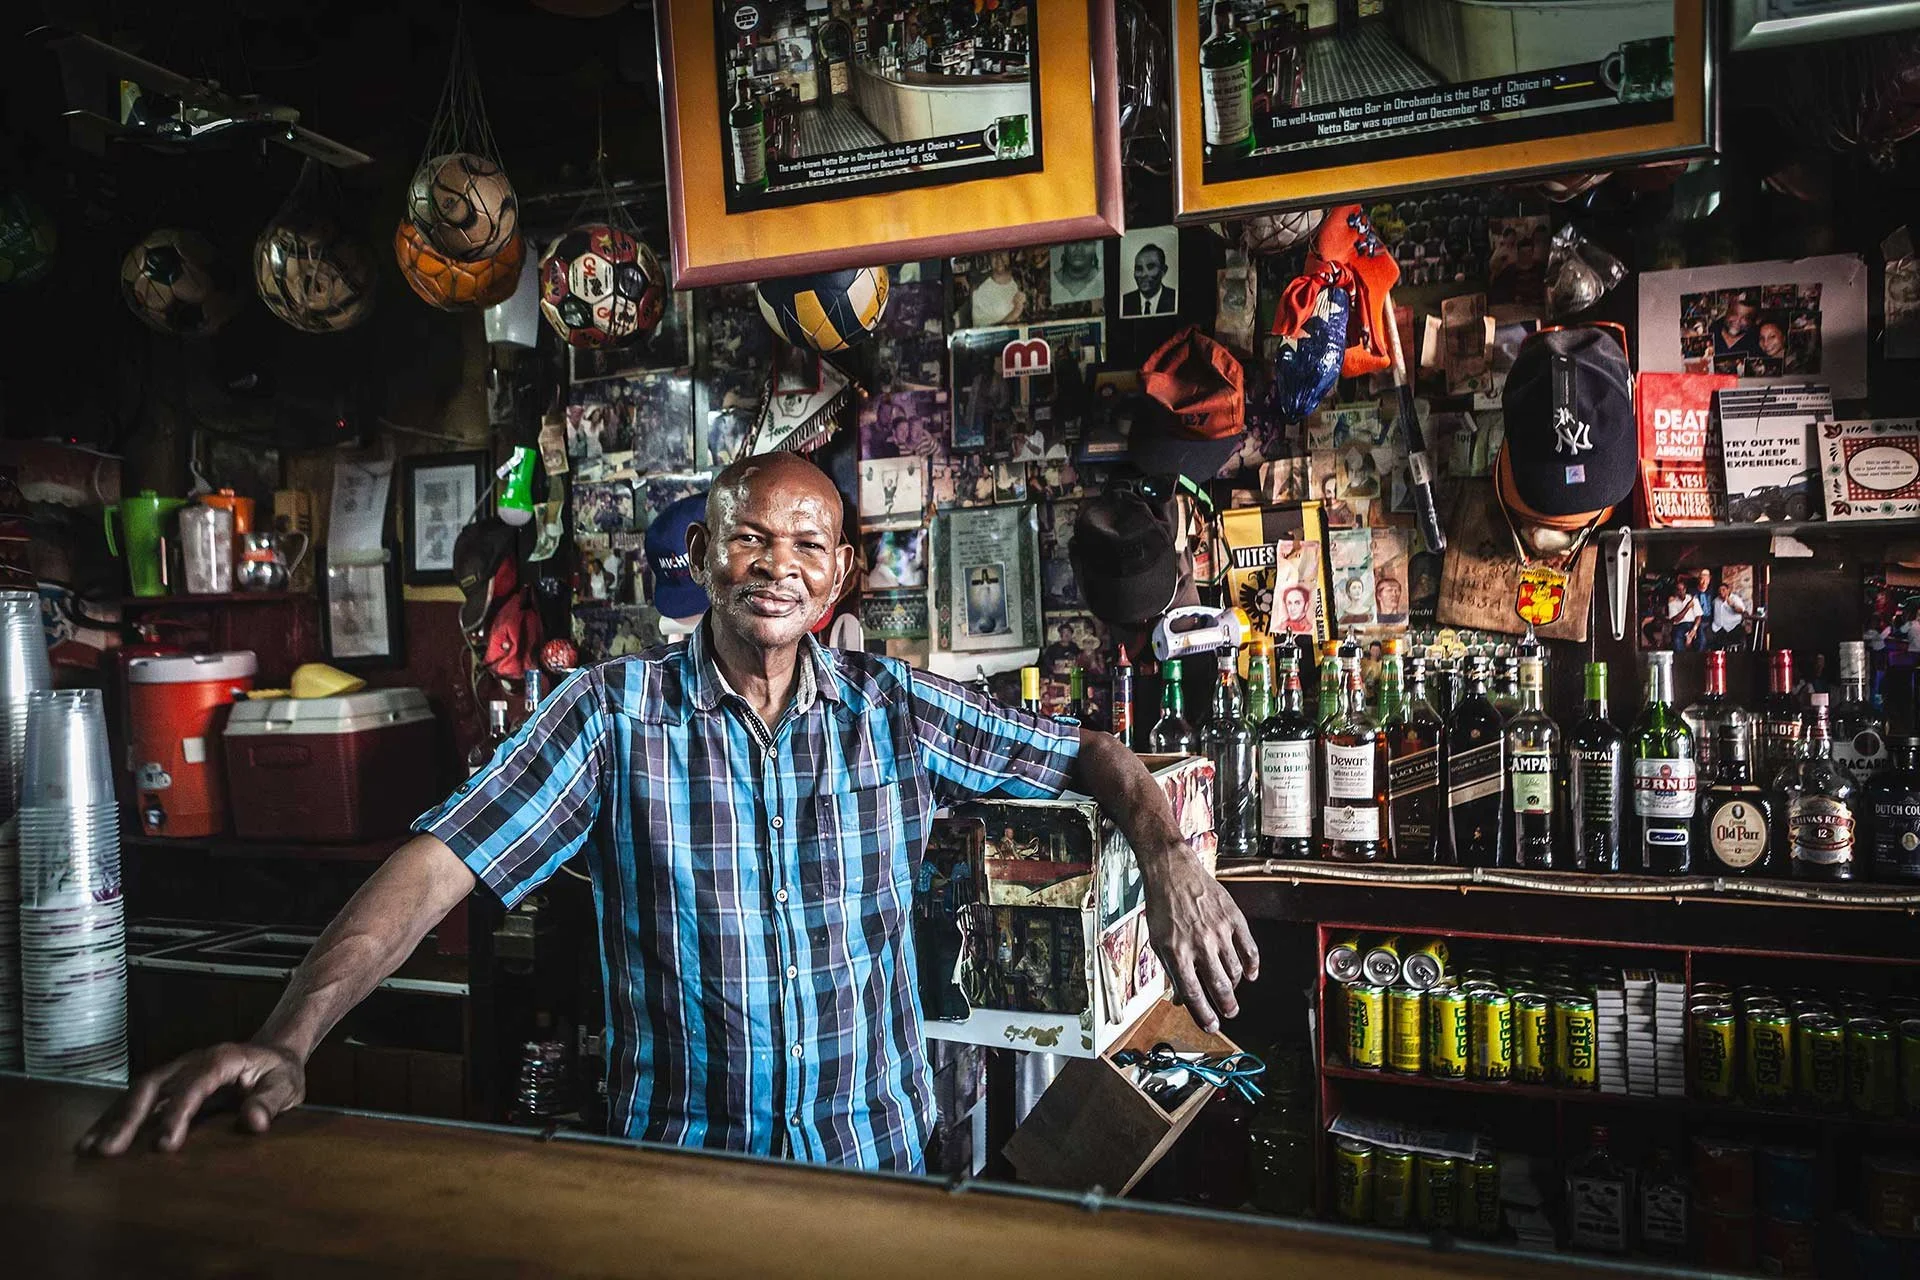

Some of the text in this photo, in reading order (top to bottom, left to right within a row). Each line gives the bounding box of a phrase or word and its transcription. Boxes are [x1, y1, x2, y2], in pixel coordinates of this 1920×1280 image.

[1272, 78, 1551, 128] The well-known Netto Bar in Otrobanda is the Bar of Choice in
[1317, 123, 1341, 135] Netto
[1343, 120, 1360, 132] Bar
[1362, 118, 1380, 129] was
[1382, 111, 1414, 127] opened
[1417, 112, 1428, 121] on
[1430, 103, 1478, 119] December
[1501, 94, 1527, 108] 1954
[779, 163, 789, 173] The
[790, 159, 821, 171] well-known
[822, 156, 839, 168] Netto
[839, 154, 850, 164] Bar
[851, 154, 857, 162] in
[889, 148, 895, 157] is
[895, 147, 905, 156] the
[906, 145, 916, 155] Bar
[918, 144, 925, 153] of
[927, 142, 948, 151] Choice
[808, 167, 825, 178] Netto
[826, 165, 837, 176] Bar
[837, 165, 849, 174] was
[850, 161, 871, 174] opened
[872, 161, 880, 170] on
[880, 157, 910, 170] December
[1655, 431, 1718, 446] IS NOT TH
[1725, 437, 1801, 449] TRY OUT THE
[1726, 449, 1787, 458] REAL JEEP
[1726, 459, 1802, 469] EXPERIENCE.
[1267, 751, 1291, 759] NETTO
[1389, 767, 1414, 781] BLACK
[1875, 804, 1904, 815] DUTCH
[1717, 825, 1760, 842] Old Parr
[1570, 1016, 1589, 1069] SPEED
[1758, 1029, 1776, 1083] SPEED
